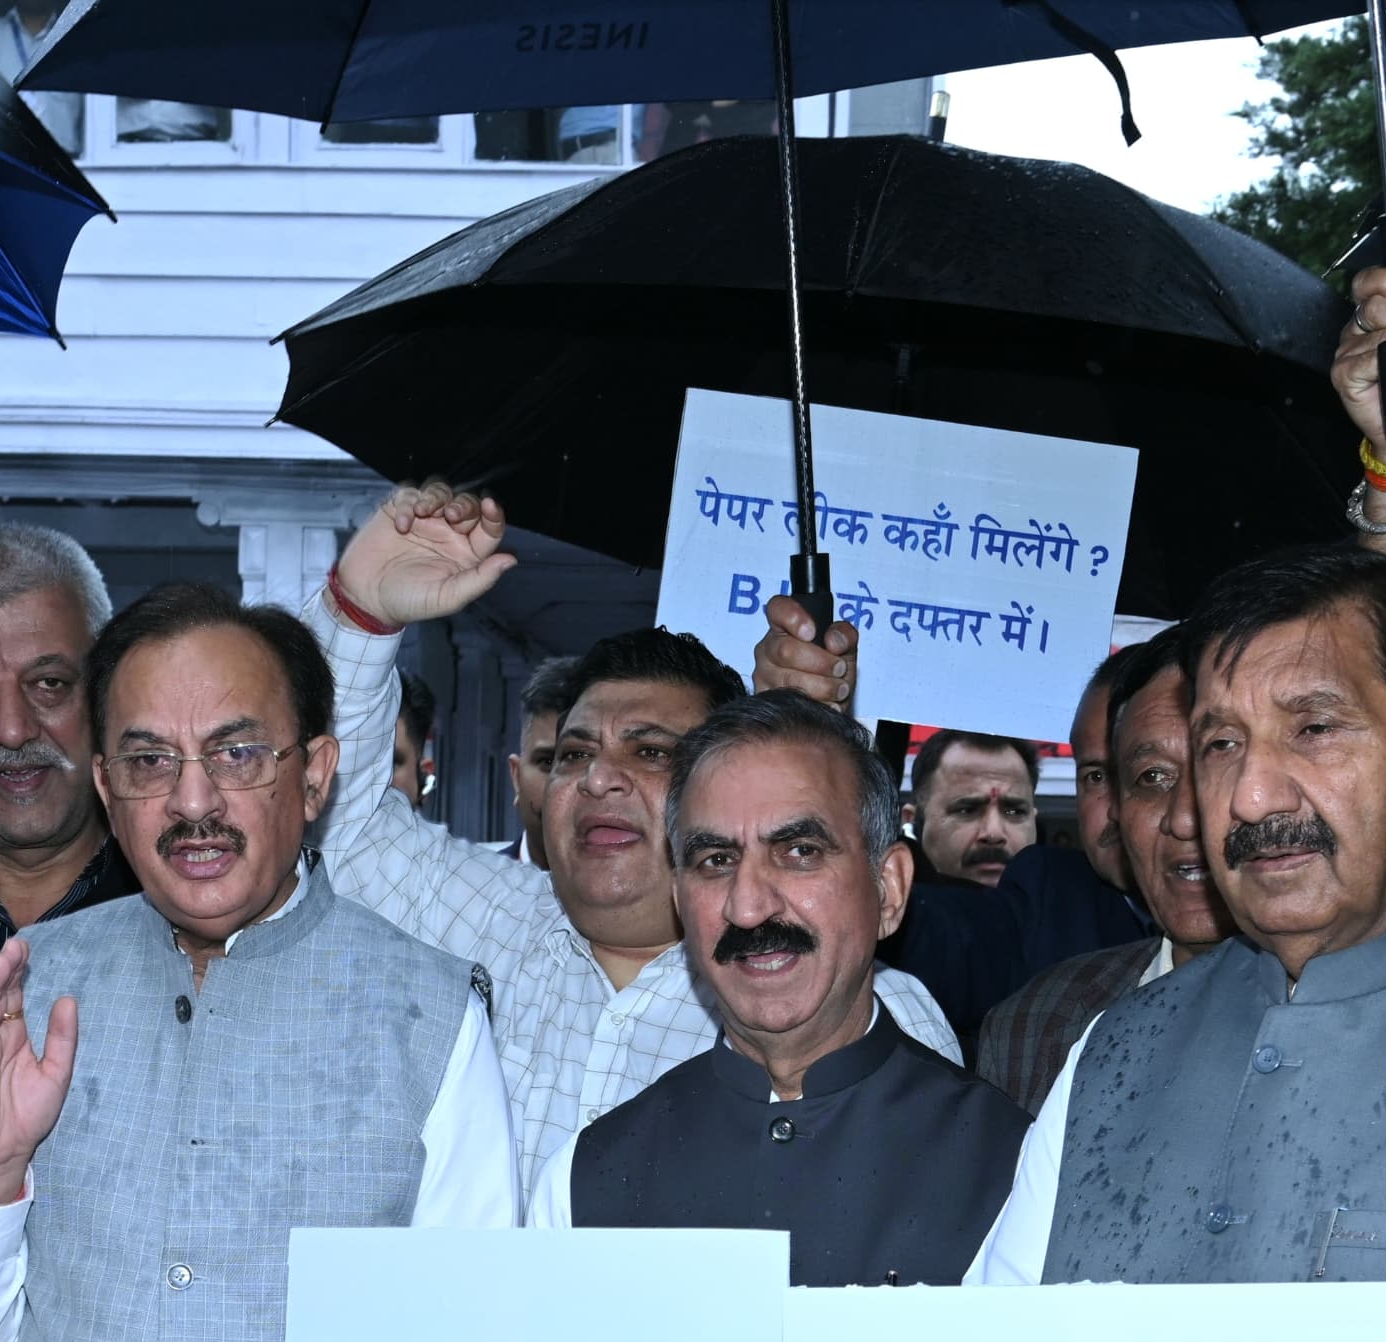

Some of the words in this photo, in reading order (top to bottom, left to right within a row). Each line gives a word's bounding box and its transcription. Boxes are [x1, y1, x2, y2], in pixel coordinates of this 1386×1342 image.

[696, 477, 774, 532] पेपर
[882, 502, 960, 561] कहाँ
[969, 514, 1080, 573] मिलेंगे
[1090, 546, 1108, 576] ?
[835, 581, 879, 632] के
[888, 600, 991, 646] दफ्तर
[999, 601, 1049, 653] में।
